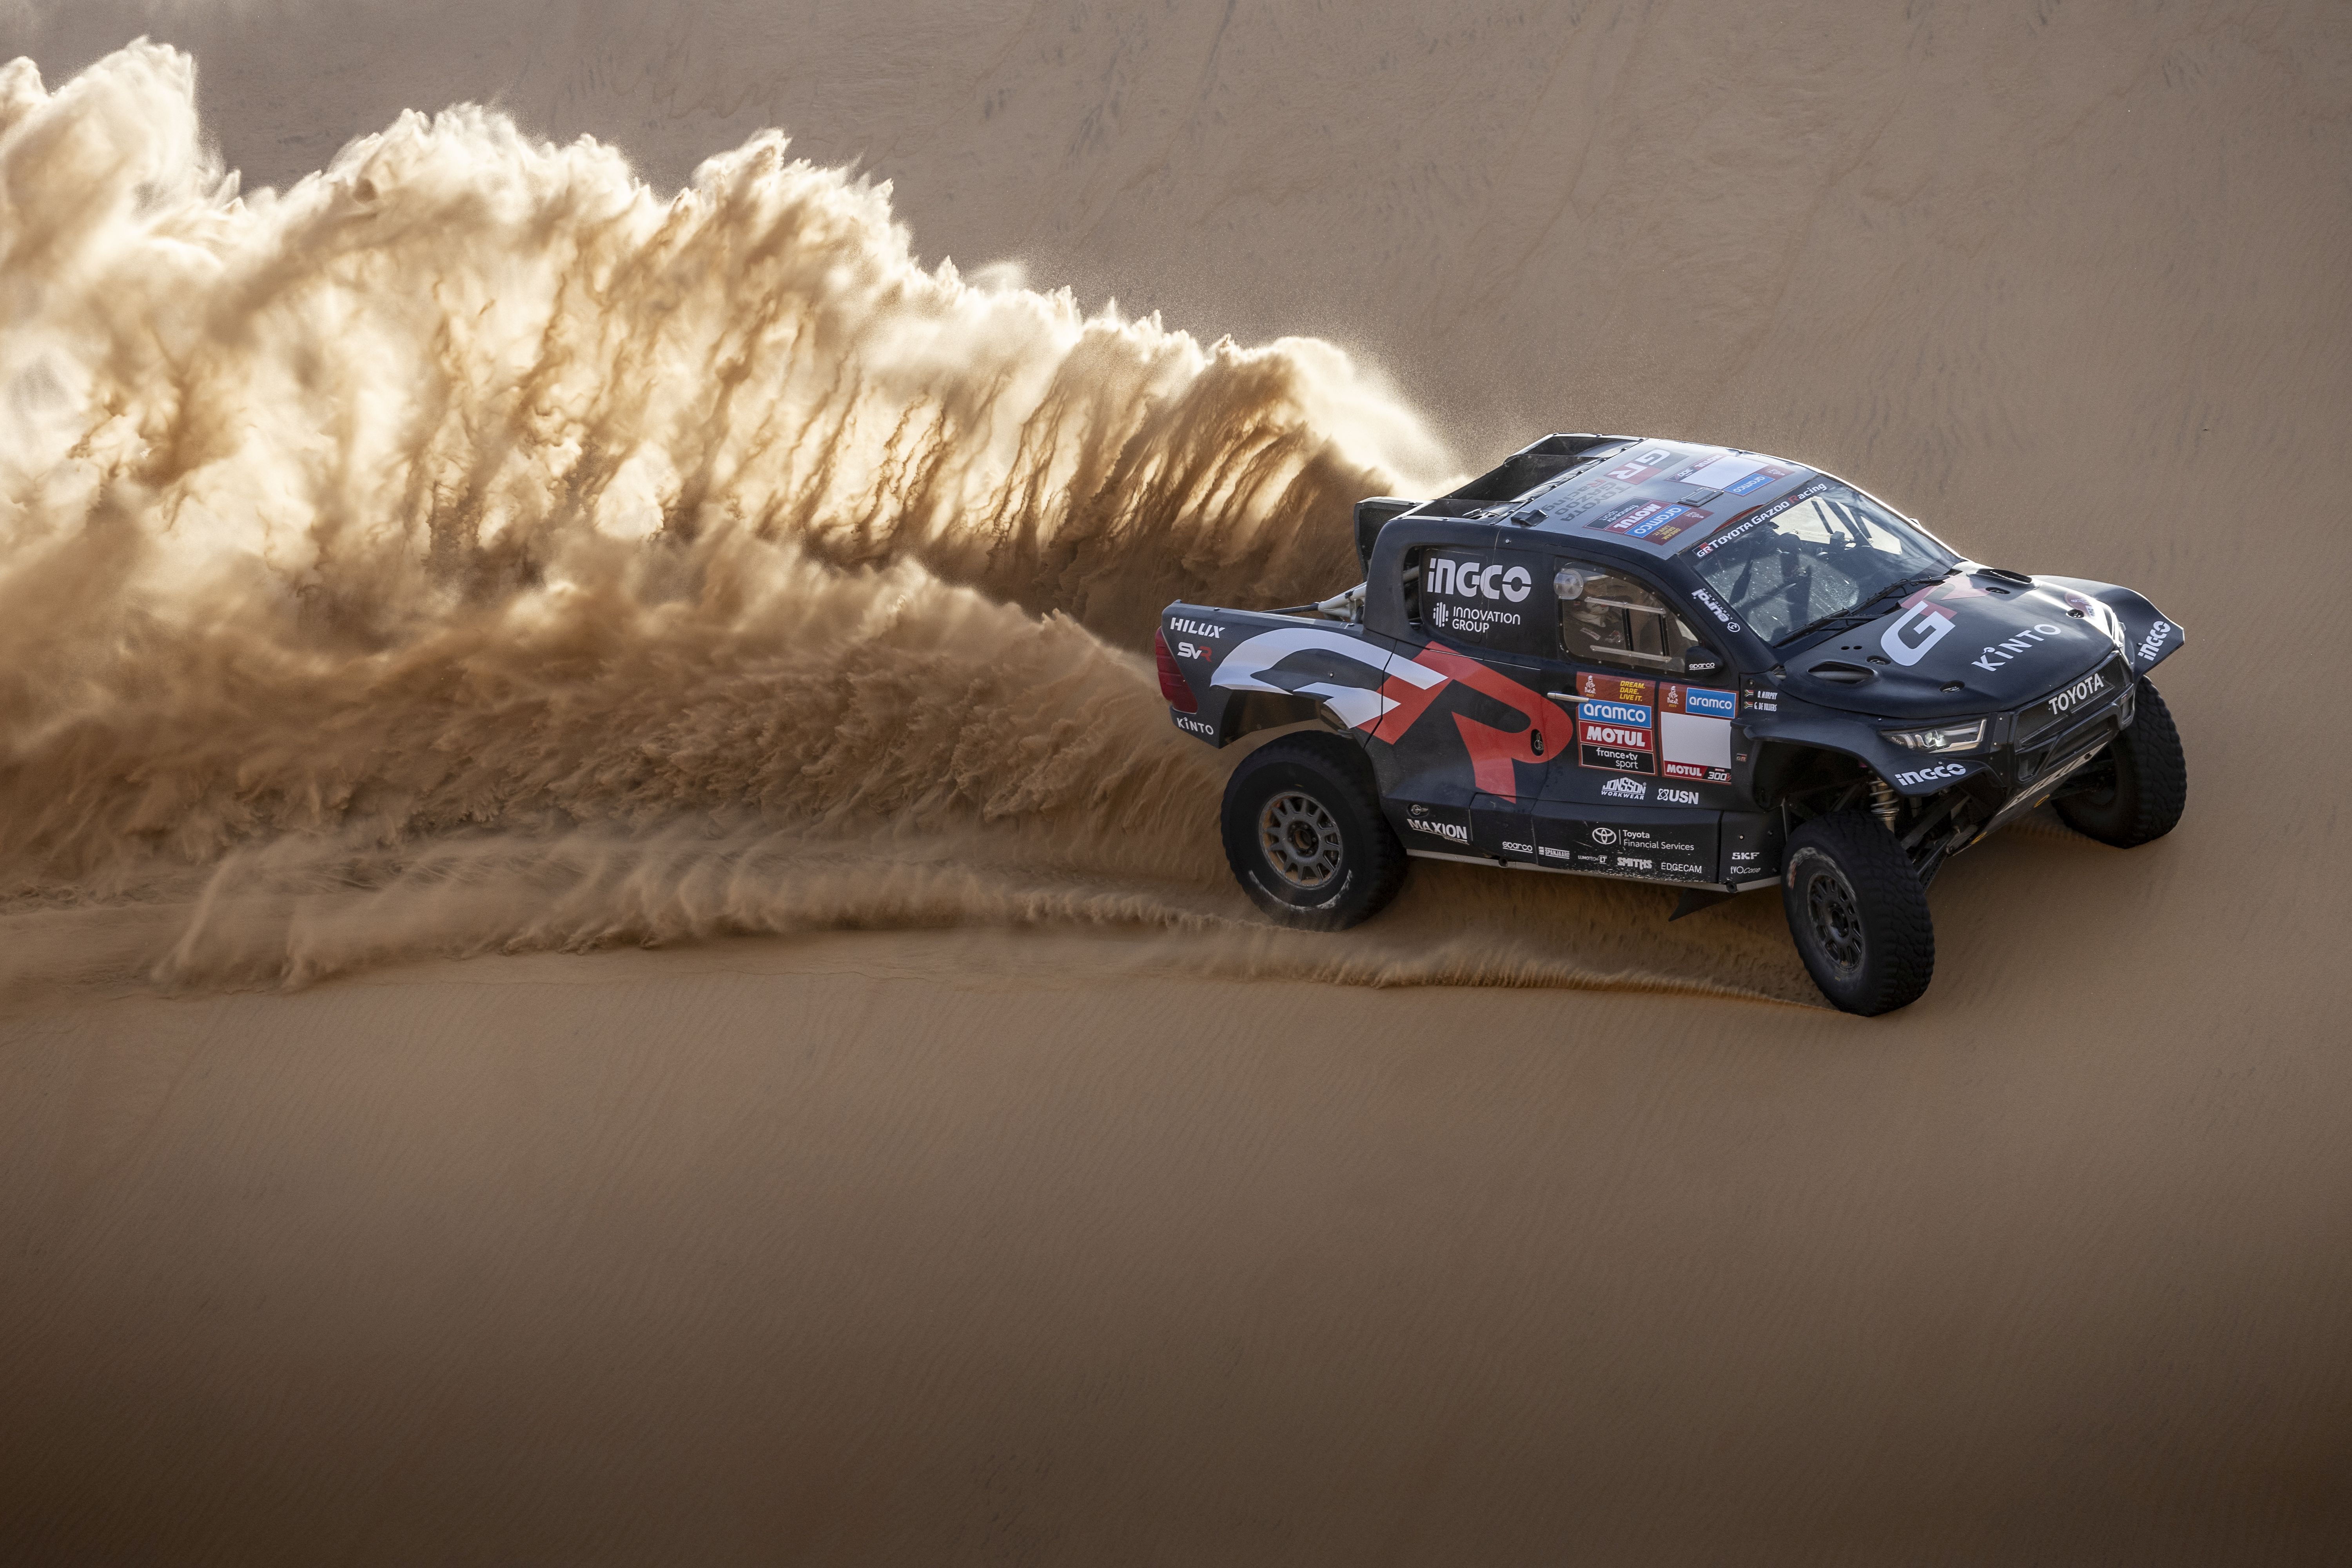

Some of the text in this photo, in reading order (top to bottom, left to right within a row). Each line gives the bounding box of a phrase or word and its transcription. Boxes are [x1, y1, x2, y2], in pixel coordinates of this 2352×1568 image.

[1733, 476, 1765, 492] aramco
[1555, 482, 1617, 515] GAZOO
[1560, 486, 1632, 521] TOYOTA
[1613, 504, 1662, 528] MOTUL
[1634, 508, 1682, 534] aramco
[1696, 483, 1827, 558] GR TOYOTA GAZOO Racing
[1691, 589, 1729, 622] eurol
[1453, 606, 1520, 625] INNOVATION
[1170, 617, 1225, 639] HILUX
[1452, 619, 1489, 633] GROUP
[1177, 642, 1212, 662] SVR
[1620, 681, 1645, 689] DREAM.
[1762, 691, 1778, 700] MURPHY
[2049, 673, 2104, 715] TOYOTA
[1689, 696, 1732, 710] aramco
[1584, 704, 1646, 722] aramco
[1586, 726, 1645, 747] MOTUL
[1616, 760, 1638, 769] sport
[1666, 764, 1702, 776] MOTUL
[1602, 777, 1646, 794] JONSSON
[1601, 790, 1644, 800] WORKWEAR
[1669, 790, 1699, 804] USN
[1407, 819, 1467, 839] MAXION
[1622, 830, 1650, 839] Toyota
[1502, 841, 1533, 851] sparco
[1624, 839, 1694, 850] Financial Services
[1617, 857, 1652, 869] SMITHS
[1661, 863, 1702, 873] EDGECAM
